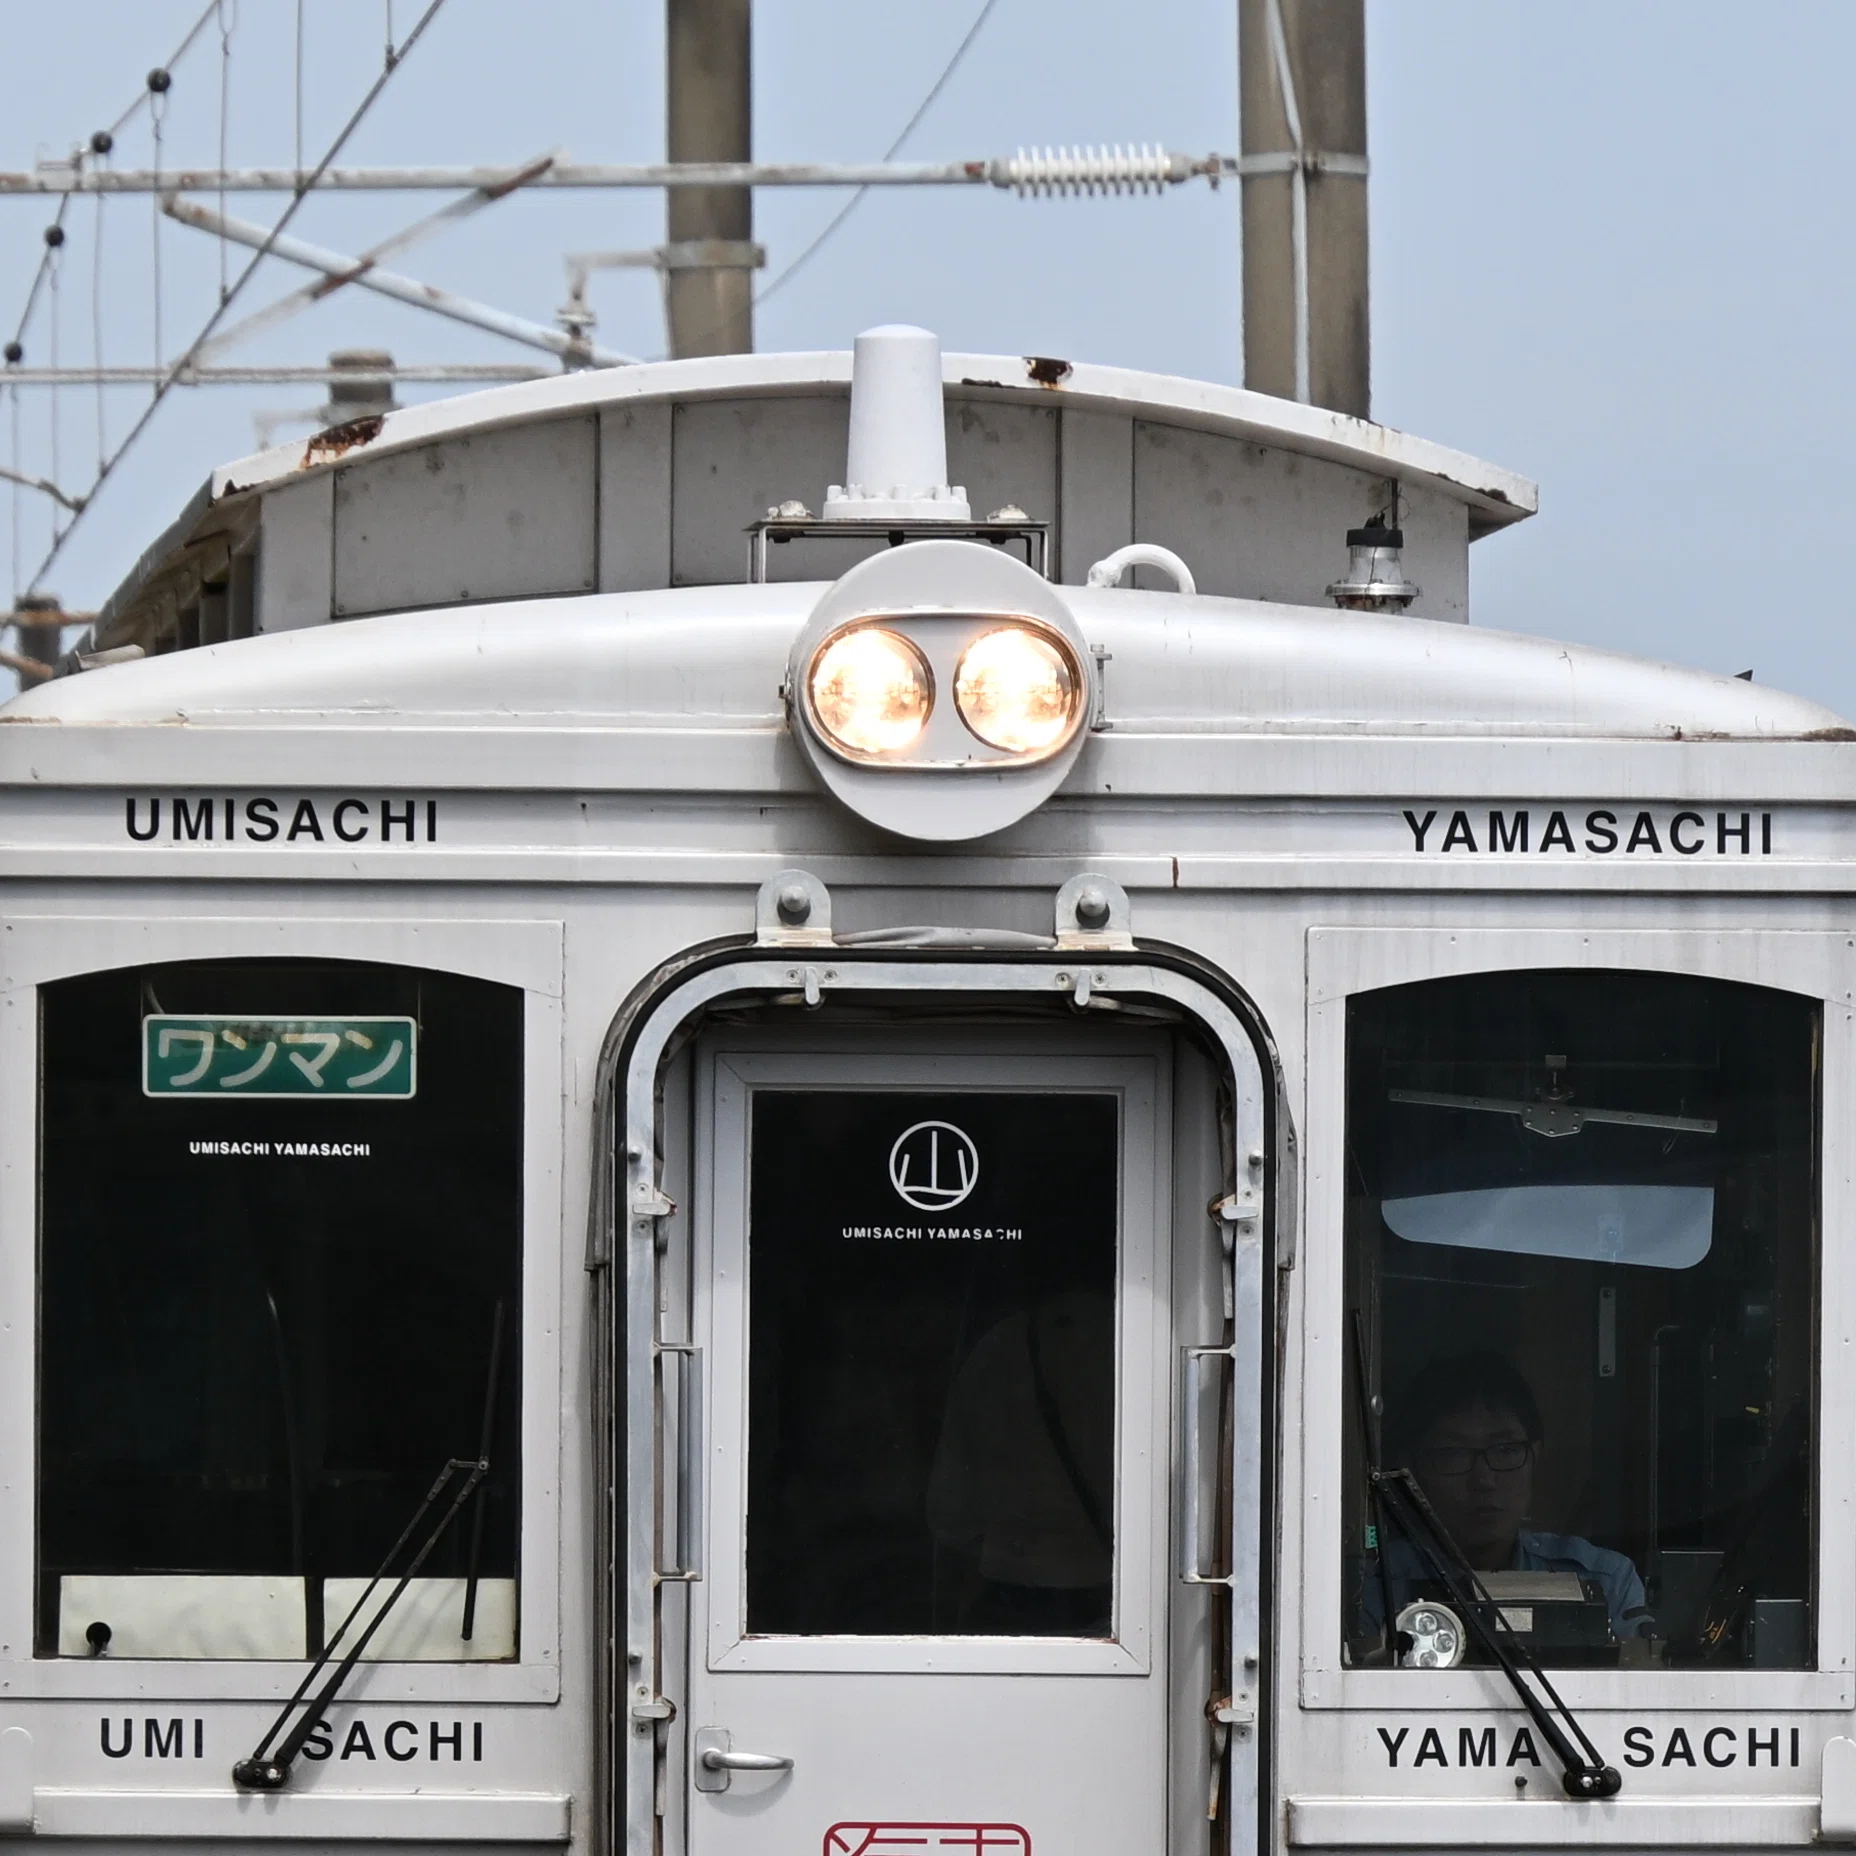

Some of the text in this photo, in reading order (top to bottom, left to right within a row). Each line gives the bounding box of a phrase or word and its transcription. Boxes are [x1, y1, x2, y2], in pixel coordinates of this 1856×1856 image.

[125, 797, 437, 842] UMISACHI
[1402, 810, 1772, 855] YAMASACHI
[158, 1028, 403, 1087] ワンマン
[189, 1141, 370, 1157] UMISACHI YAMASACHI
[843, 1226, 922, 1240] UMISACHI
[100, 1718, 483, 1761] UMI SACHI
[1376, 1727, 1801, 1768] YAMA SACHI
